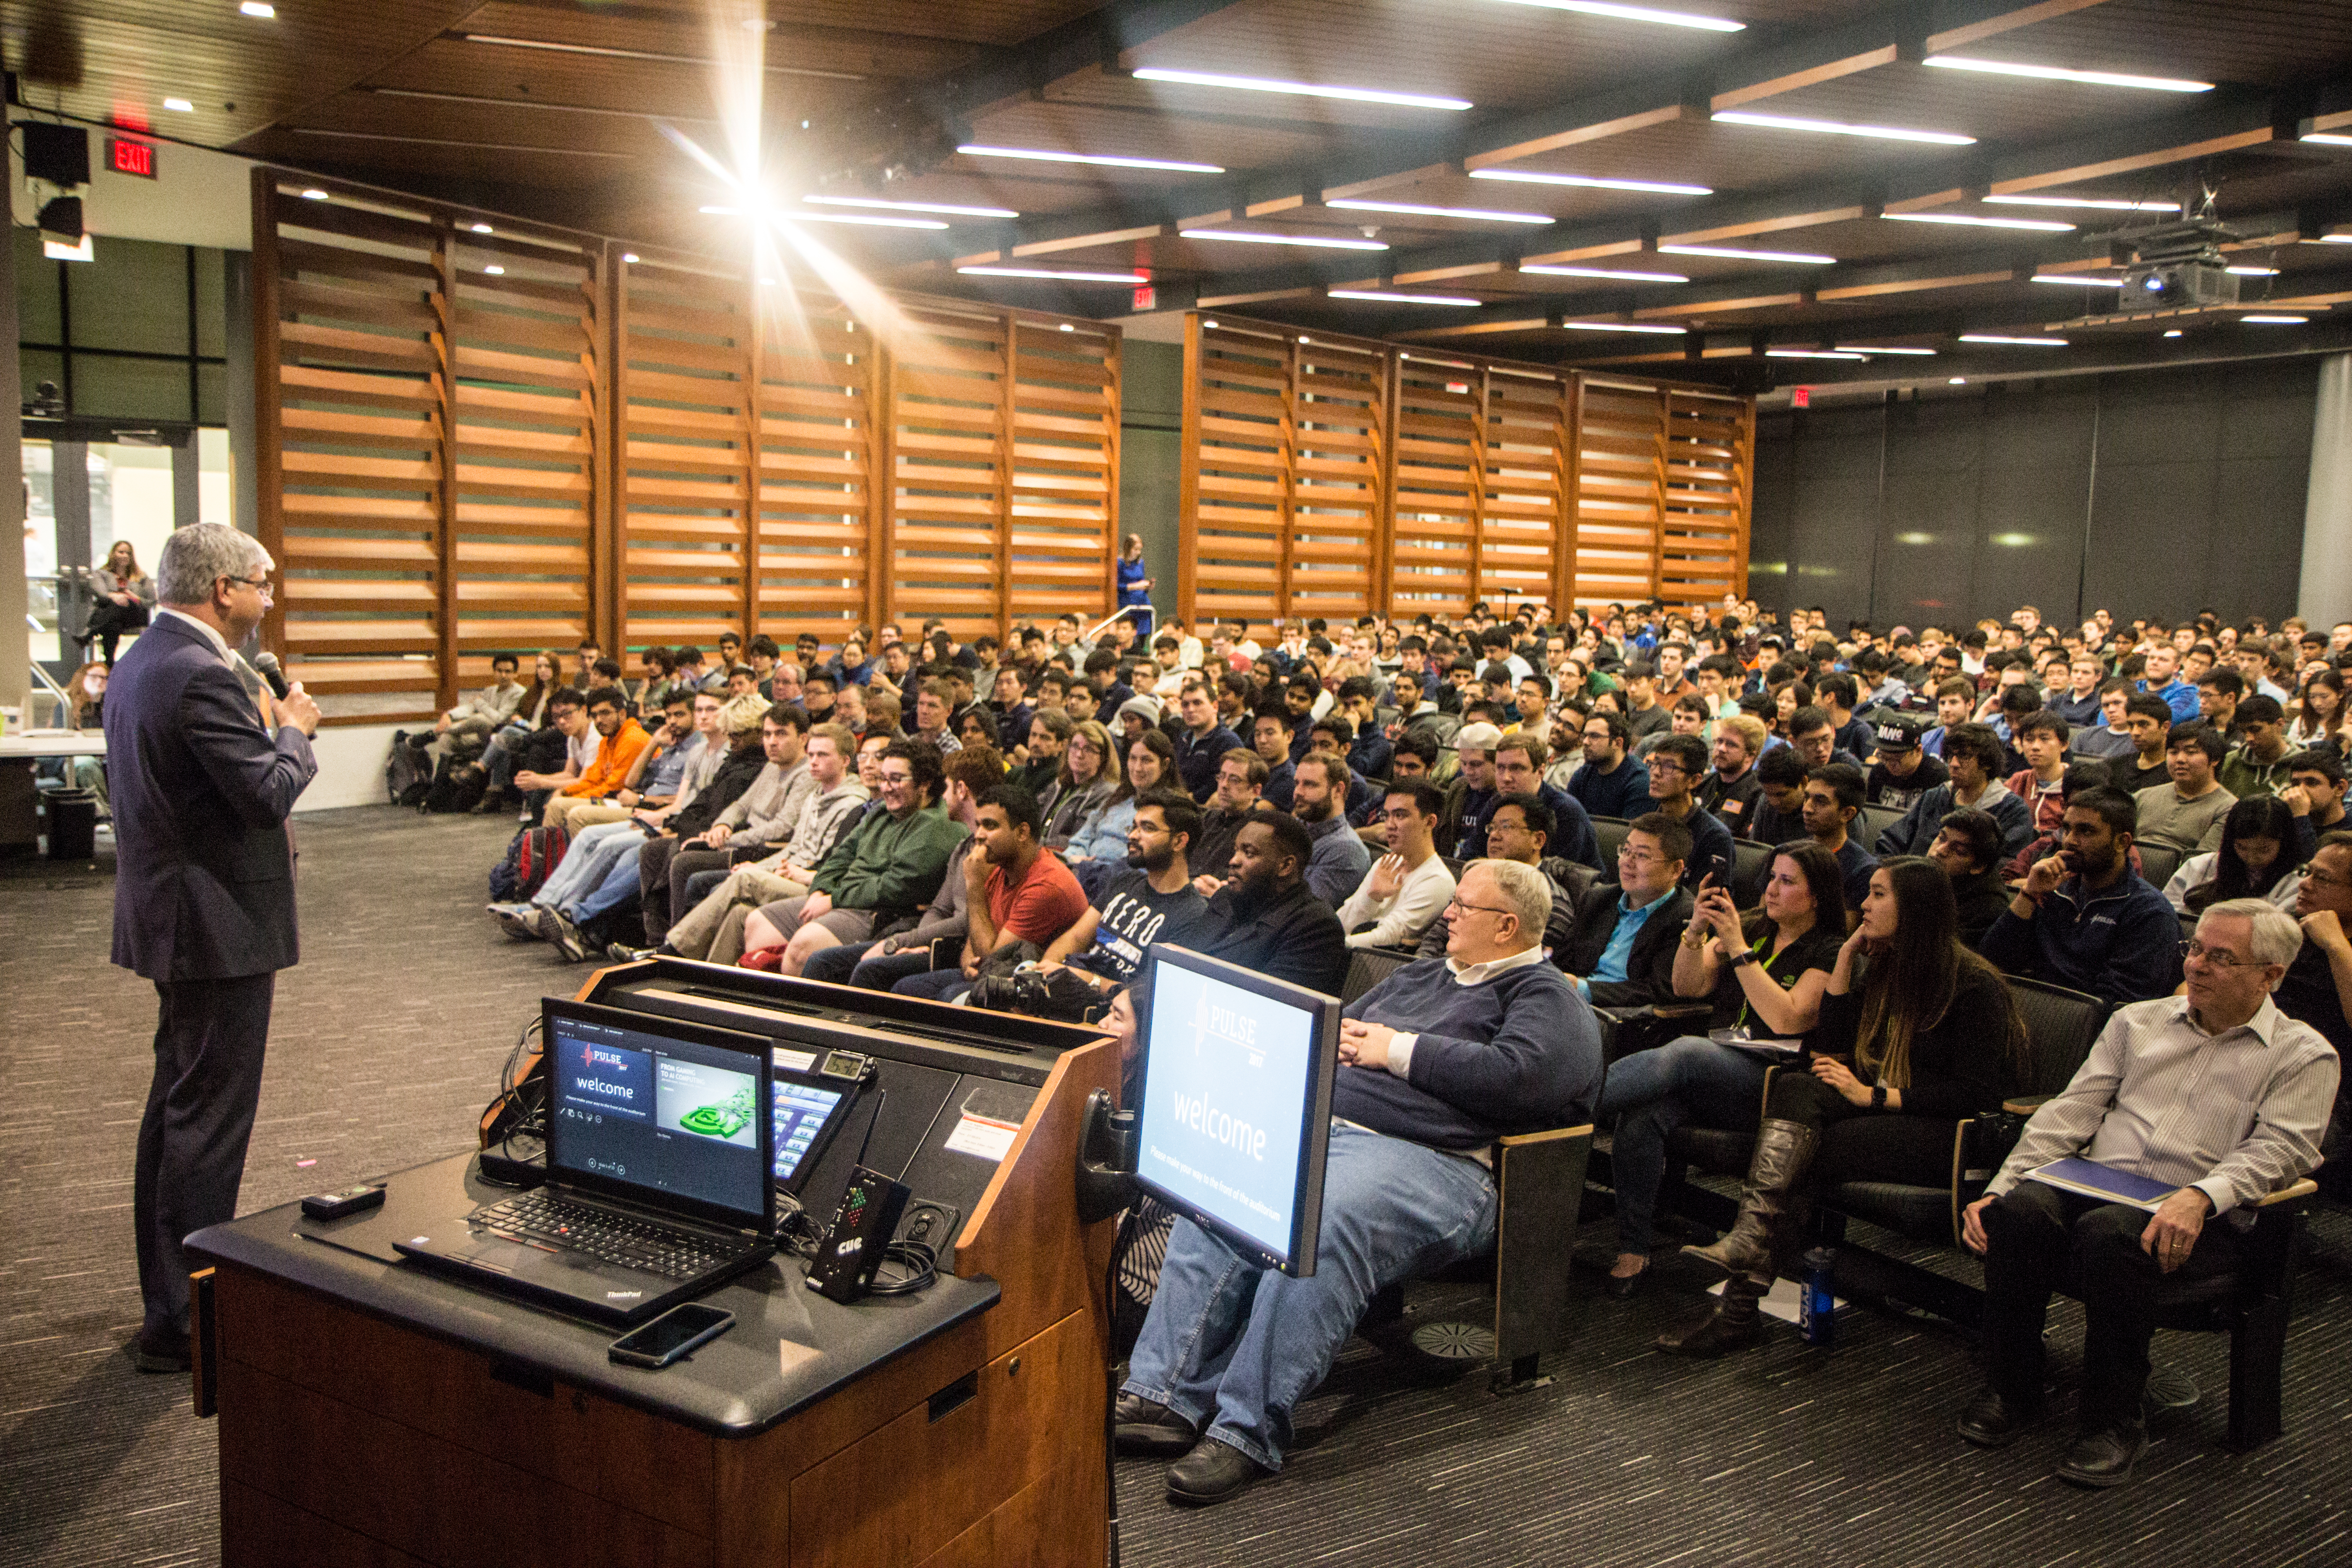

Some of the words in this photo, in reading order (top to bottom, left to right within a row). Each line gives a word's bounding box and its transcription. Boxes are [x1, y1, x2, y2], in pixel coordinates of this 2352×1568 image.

[115, 140, 152, 175] EXIT
[1210, 1004, 1257, 1045] PULSE
[594, 1050, 622, 1064] PULSE
[1249, 1052, 1264, 1068] 2017
[661, 1063, 675, 1072] FROM
[676, 1066, 696, 1076] GAMING
[577, 1077, 633, 1098] welcome
[676, 1074, 705, 1085] COMPUTING
[1174, 1090, 1266, 1161] welcome
[1150, 1144, 1166, 1159] Please
[1166, 1156, 1180, 1169] make
[1180, 1163, 1192, 1174] your
[1192, 1169, 1203, 1183] way
[1203, 1173, 1209, 1184] to
[1210, 1176, 1219, 1189] the
[1219, 1181, 1233, 1197] front
[1233, 1189, 1240, 1200] of
[1240, 1192, 1250, 1205] the
[1250, 1199, 1280, 1222] auditorium
[838, 1237, 862, 1254] cue
